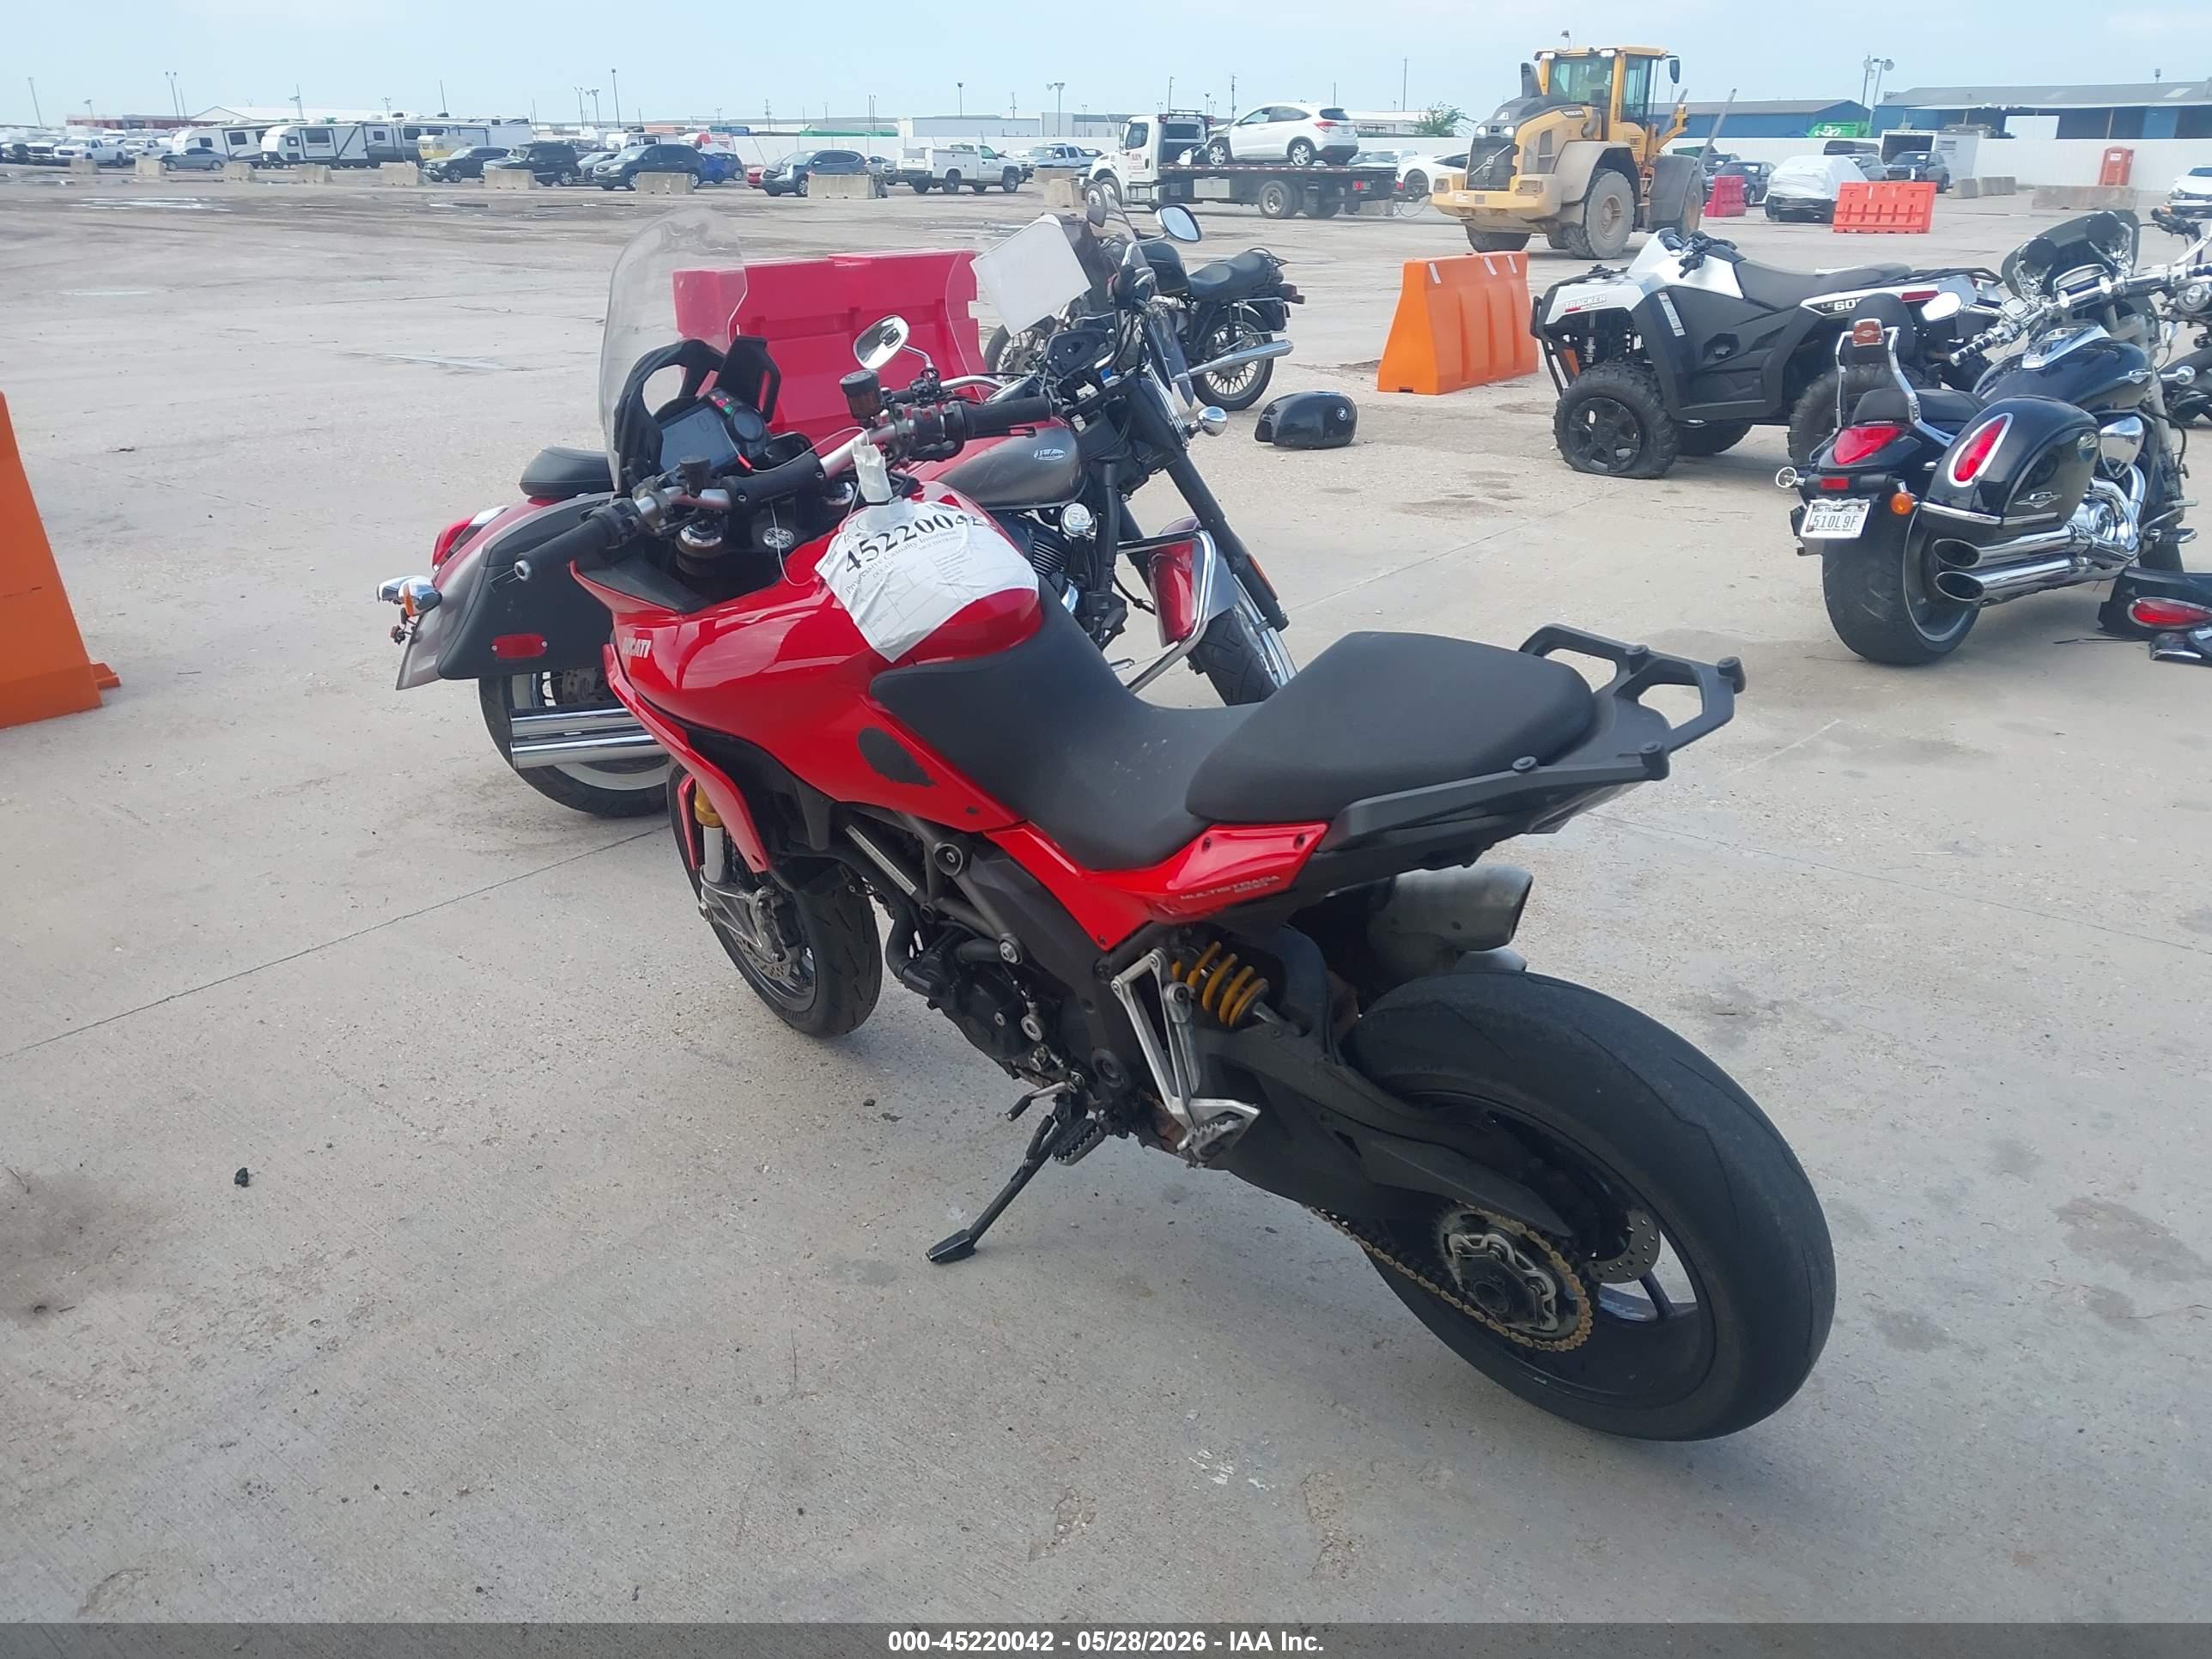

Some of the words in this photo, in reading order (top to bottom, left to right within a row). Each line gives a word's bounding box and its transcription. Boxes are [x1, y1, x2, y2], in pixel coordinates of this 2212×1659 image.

[1565, 295, 1607, 309] TRACKER
[1036, 449, 1065, 459] Vulcan
[1813, 514, 1859, 529] 510L9F
